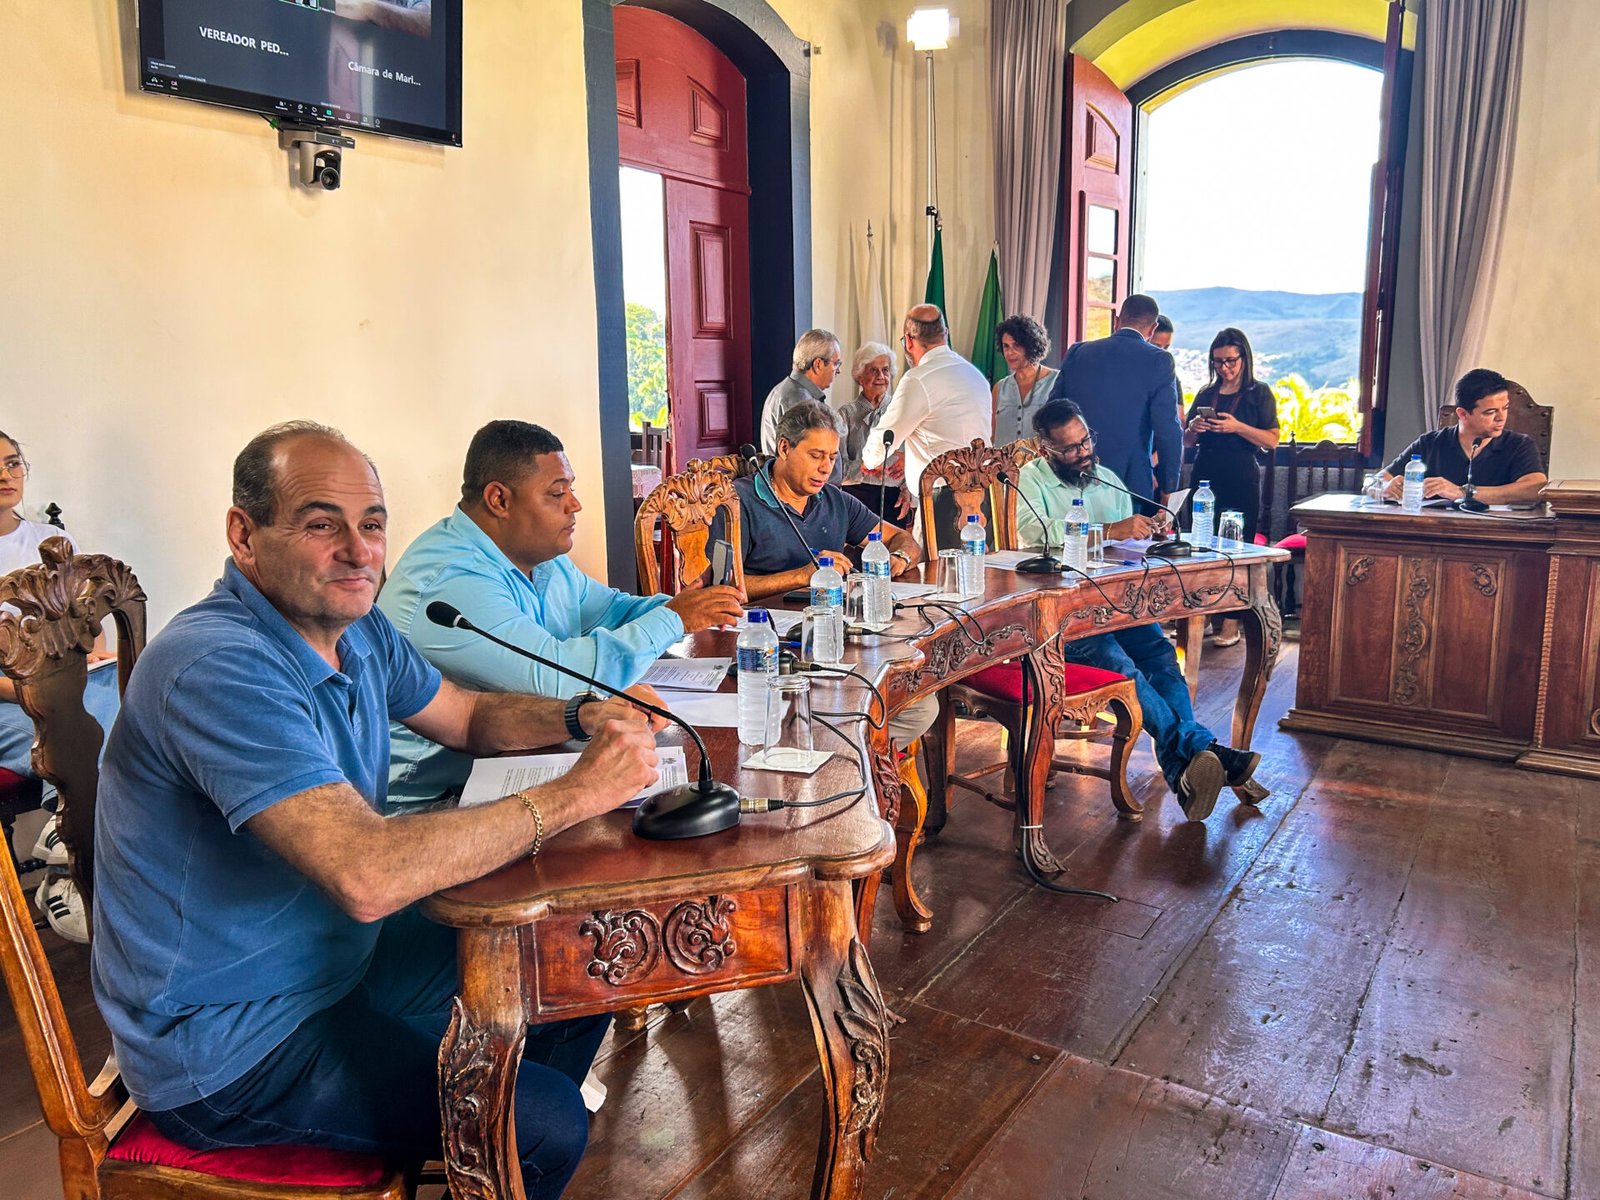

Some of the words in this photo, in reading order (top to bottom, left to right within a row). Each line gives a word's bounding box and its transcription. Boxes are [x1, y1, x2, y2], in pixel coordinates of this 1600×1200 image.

[199, 26, 256, 49] VEREADOR
[260, 40, 289, 56] PED...
[348, 61, 379, 76] Câmara
[382, 69, 393, 79] de
[395, 72, 421, 86] Mari...
